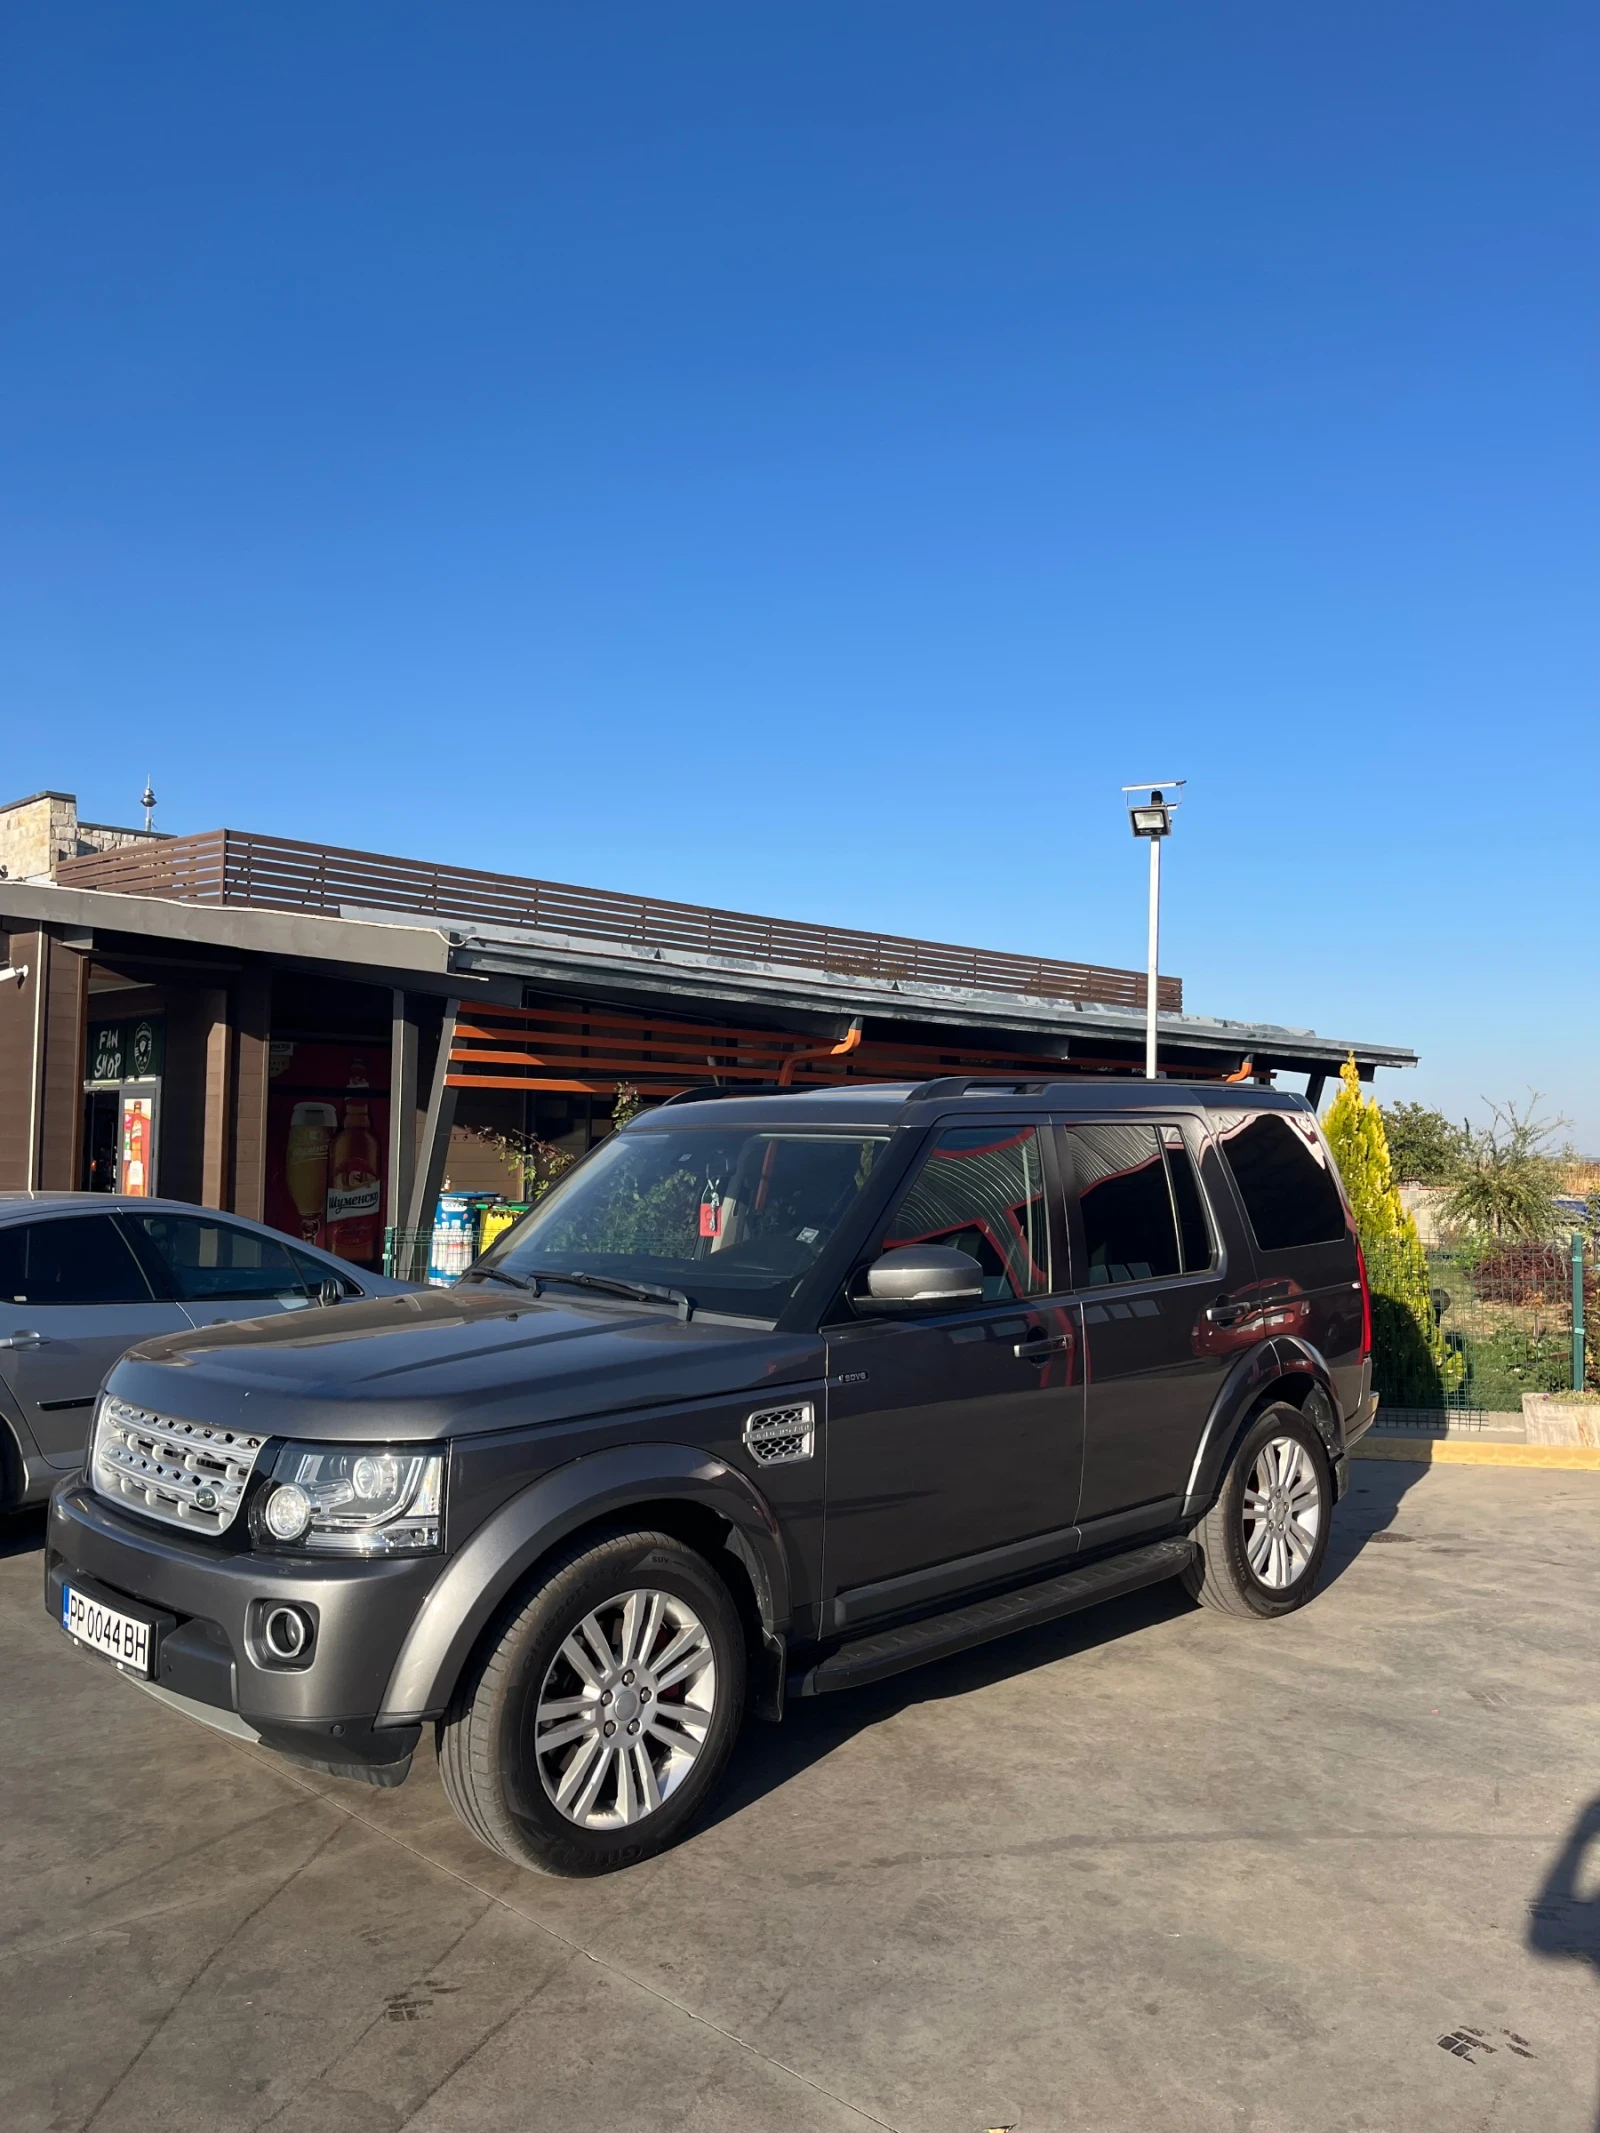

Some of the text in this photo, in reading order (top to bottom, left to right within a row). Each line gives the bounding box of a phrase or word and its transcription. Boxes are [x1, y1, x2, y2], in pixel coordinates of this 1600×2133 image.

[99, 1029, 119, 1050] FAN
[94, 1053, 121, 1078] SHOP
[328, 1191, 379, 1215] Шуменско
[651, 1556, 670, 1564] SUV
[70, 1594, 147, 1665] PP0044BH
